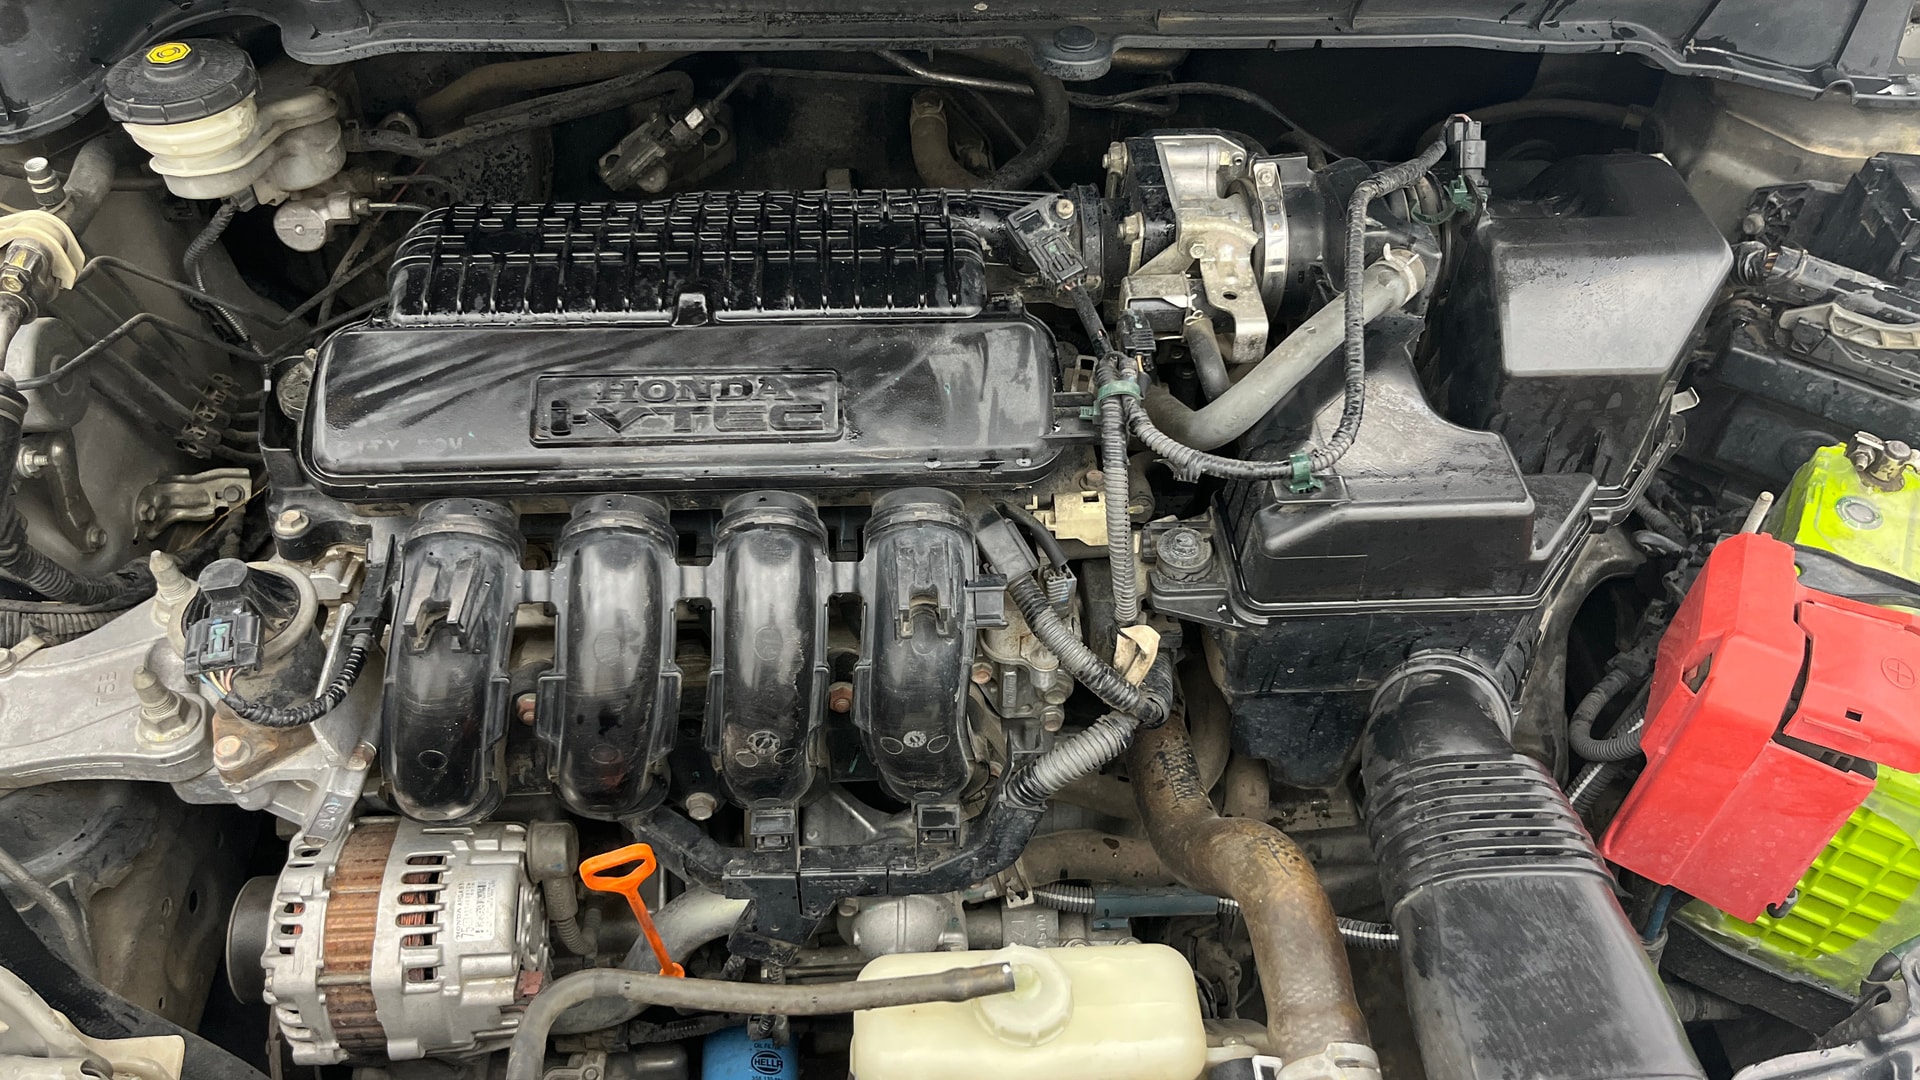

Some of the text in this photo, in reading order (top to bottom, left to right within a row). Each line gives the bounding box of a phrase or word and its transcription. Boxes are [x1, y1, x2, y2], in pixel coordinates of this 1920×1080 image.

[597, 377, 794, 403] HONDA
[551, 400, 823, 435] i-VTEC
[754, 1058, 783, 1069] HELLA
